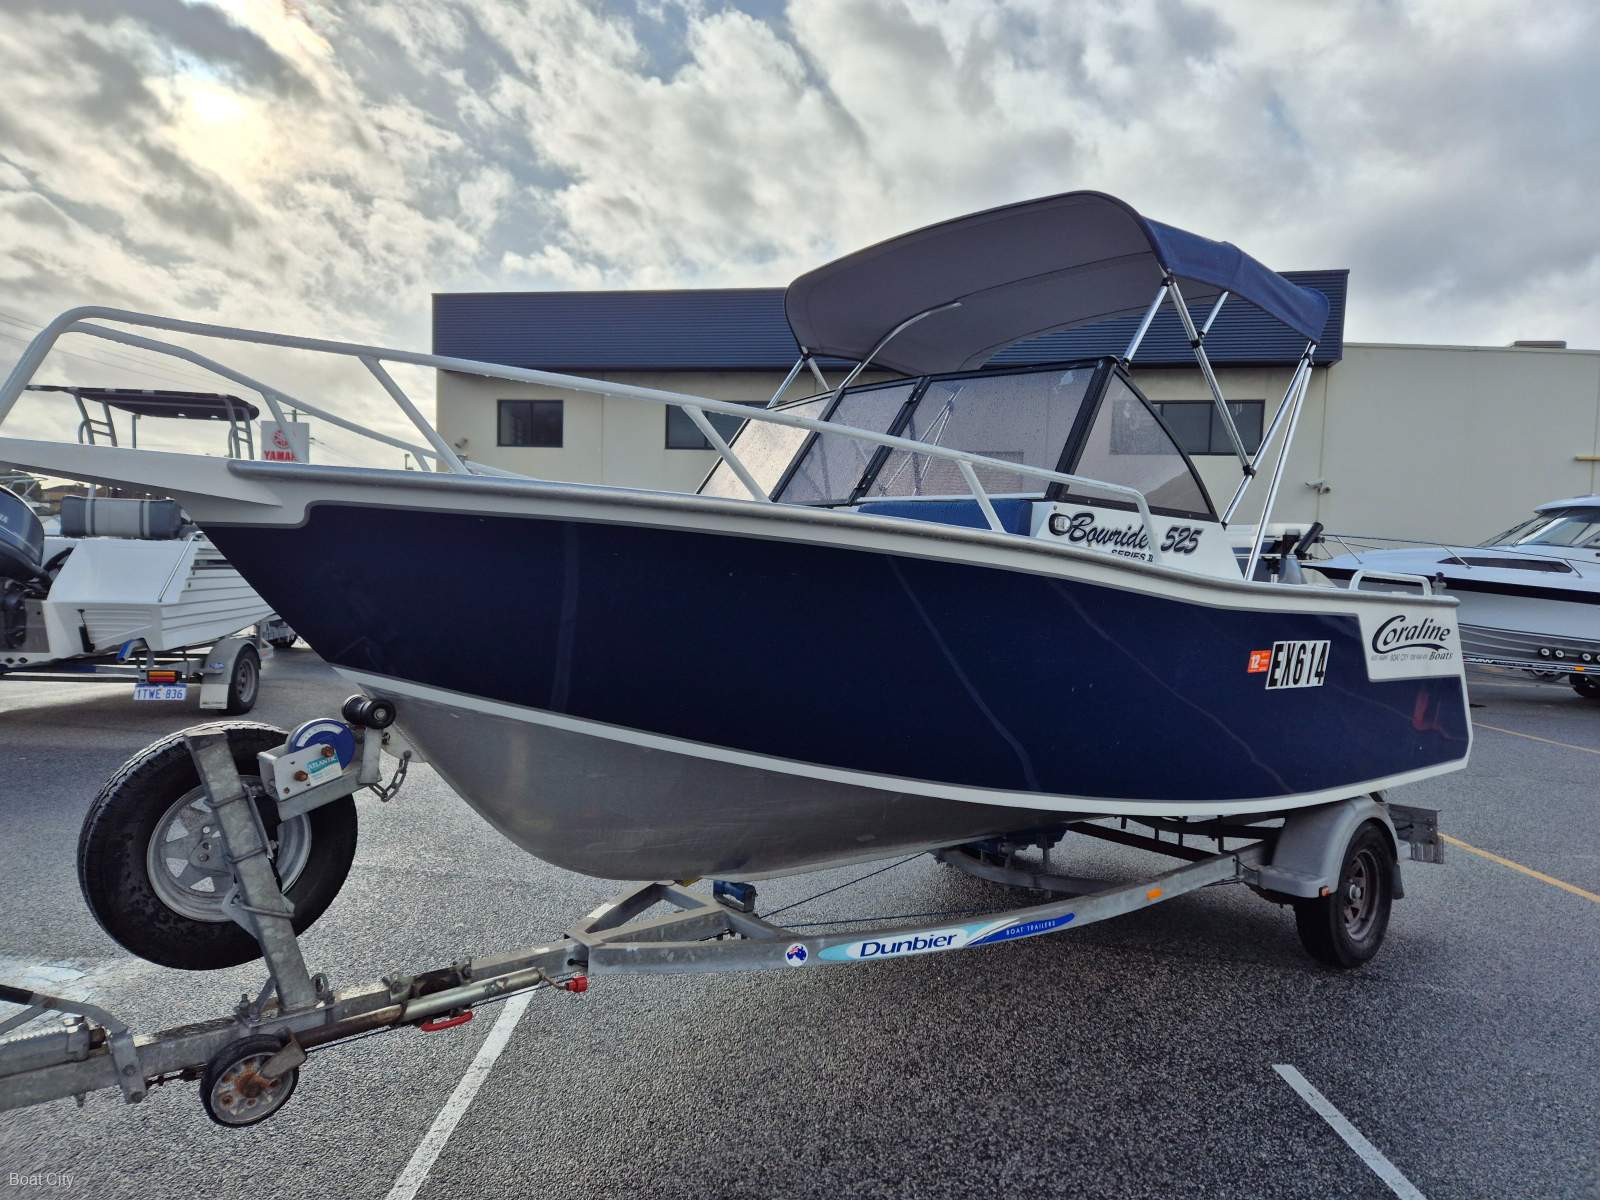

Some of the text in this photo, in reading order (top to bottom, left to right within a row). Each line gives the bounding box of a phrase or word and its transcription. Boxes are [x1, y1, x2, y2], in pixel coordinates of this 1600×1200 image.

[264, 451, 297, 461] YAMA
[1068, 512, 1203, 554] Bowride 525
[1371, 614, 1451, 653] Coraline
[1250, 654, 1261, 669] 12
[1267, 642, 1328, 687] EX614
[1428, 650, 1453, 661] Boats
[136, 688, 183, 699] 1TWE 836
[859, 919, 1056, 958] Dunbier BOAT TRAILERS
